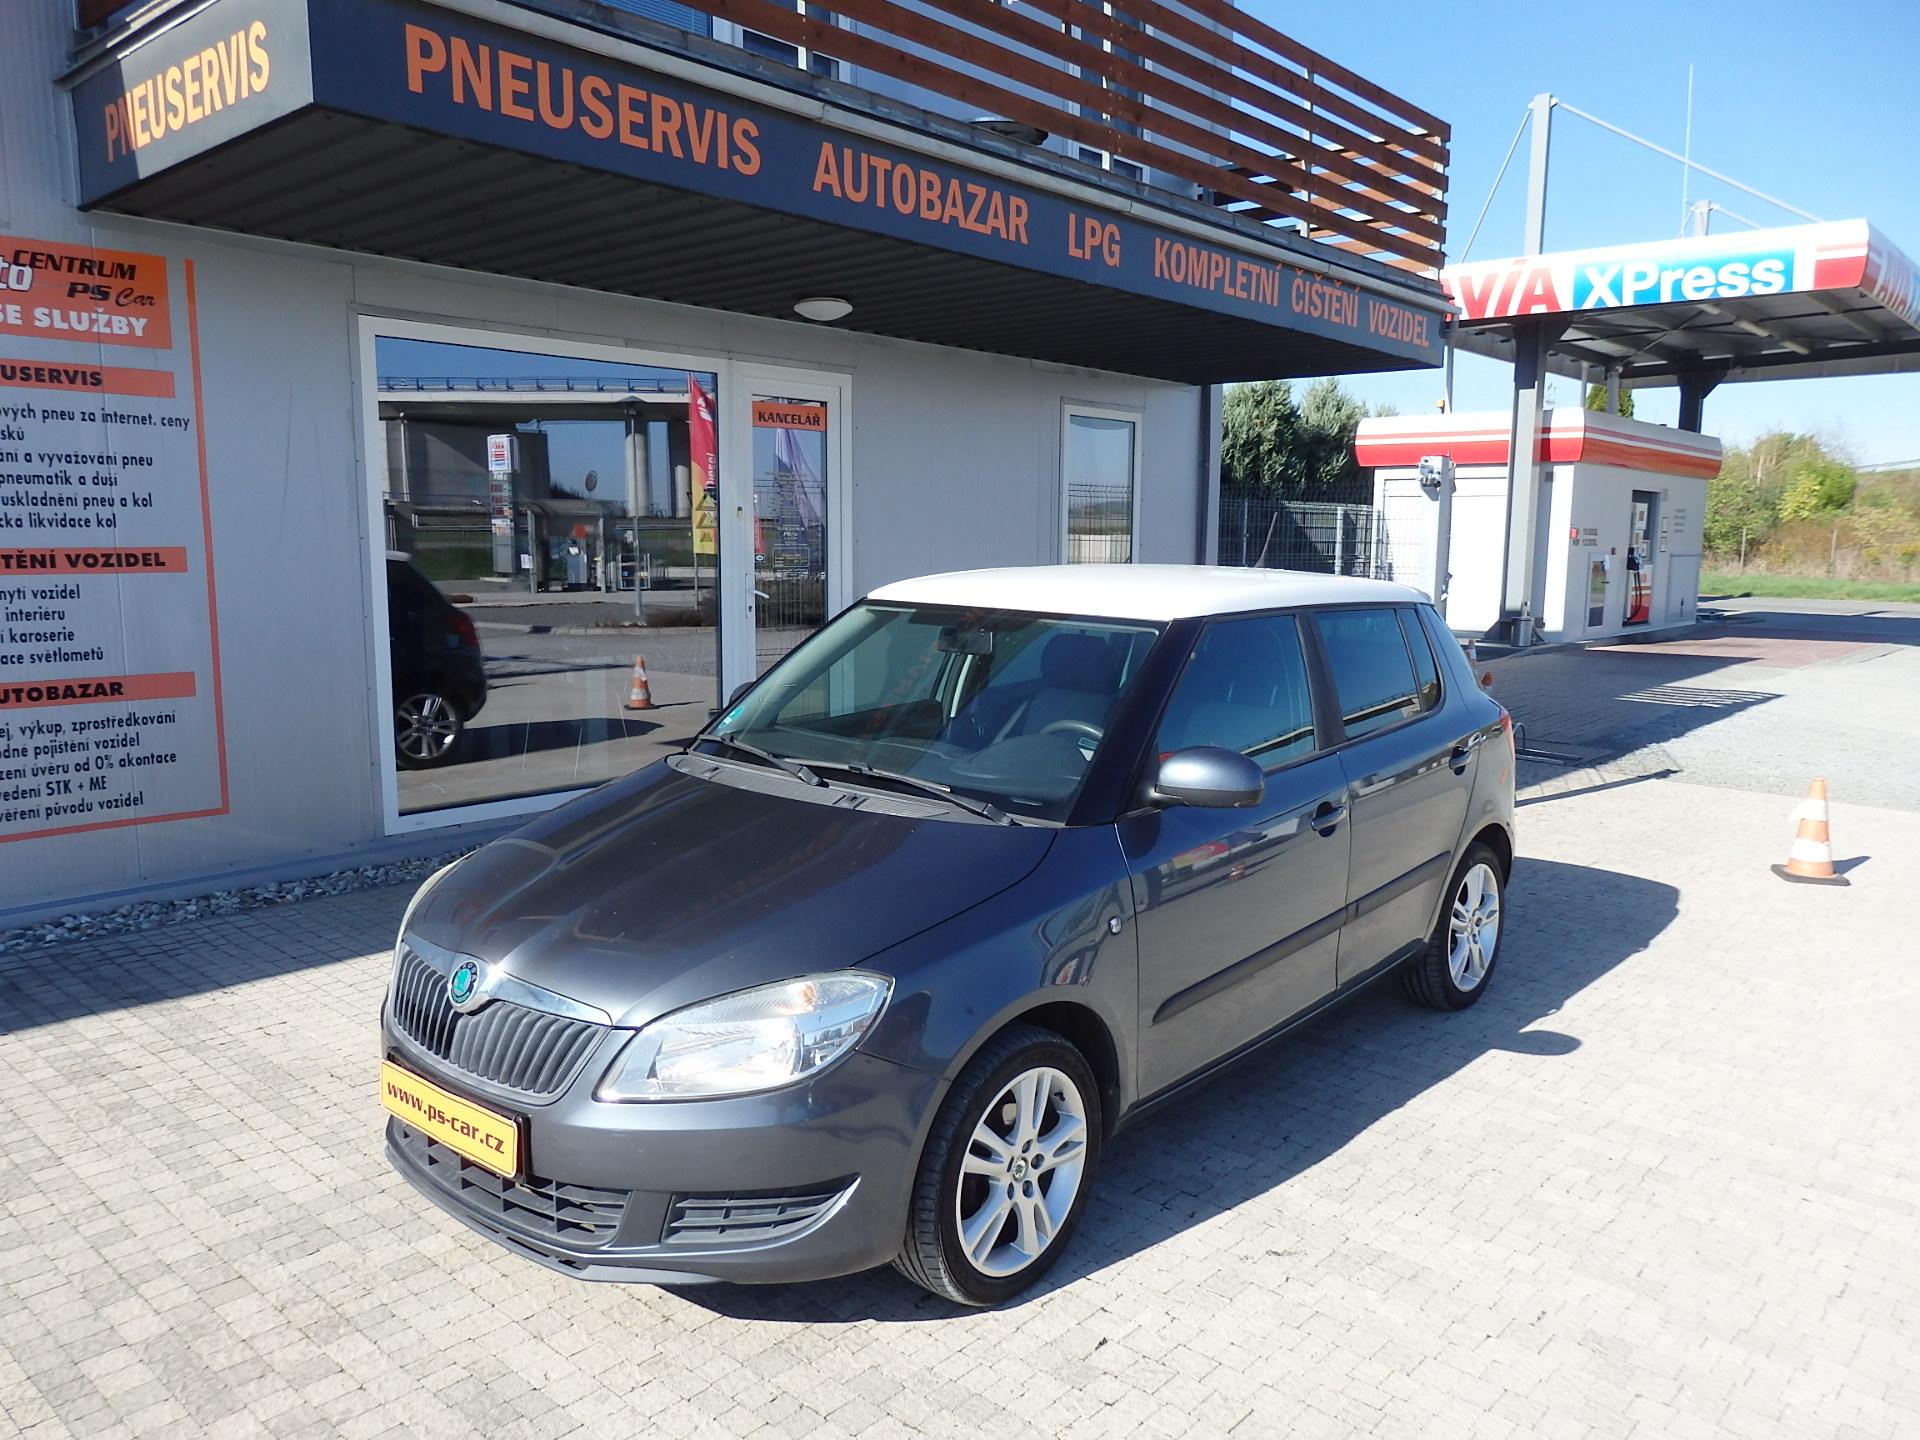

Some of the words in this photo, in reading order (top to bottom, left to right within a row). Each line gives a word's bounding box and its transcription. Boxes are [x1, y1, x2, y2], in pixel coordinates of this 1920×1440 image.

[104, 20, 271, 163] PNEUSERVIS
[405, 23, 762, 177] PNEUSERVIS
[812, 141, 1029, 245] AUTOBAZAR
[1067, 212, 1121, 268] LPG
[1154, 237, 1283, 308] KOMPLETNÍ
[1290, 266, 1360, 328] ČIŠTĚNÍ
[1368, 299, 1430, 348] VOZIDEL
[13, 249, 137, 281] CENTRUM
[67, 281, 112, 301] PS
[115, 287, 157, 307] Car
[1580, 258, 1787, 310] XPress
[34, 307, 148, 337] SLUŽBY
[0, 403, 37, 423] vých
[42, 408, 76, 424] pneu
[80, 410, 97, 423] za
[101, 407, 158, 427] internet.
[160, 415, 191, 432] ceny
[757, 410, 821, 427] KANCELÁŘ
[24, 452, 33, 463] a
[38, 450, 118, 468] vyvažování
[122, 456, 154, 470] pneu
[78, 475, 87, 486] a
[92, 471, 118, 487] duší
[1, 491, 78, 507] uskladnění
[83, 496, 115, 511] pneu
[120, 498, 128, 508] a
[132, 492, 153, 508] kol
[28, 512, 92, 529] likvidace
[96, 513, 117, 529] kol
[65, 552, 166, 569] VOZIDEL
[31, 583, 81, 600] vozidel
[5, 606, 65, 622] interiéru
[9, 627, 75, 643] karoserie
[29, 646, 104, 665] světlometů
[71, 711, 177, 736] zprostředkování
[0, 743, 29, 760] dné
[34, 739, 90, 760] pojištění
[94, 732, 140, 751] vozidel
[74, 756, 91, 773] od
[94, 754, 115, 770] 0%
[118, 752, 177, 768] akontace
[0, 784, 42, 802] edení
[46, 779, 73, 797] STK
[89, 775, 108, 792] ME
[45, 797, 94, 820] původu
[97, 791, 144, 811] vozidel
[387, 1081, 505, 1155] www.ps-car.cz
